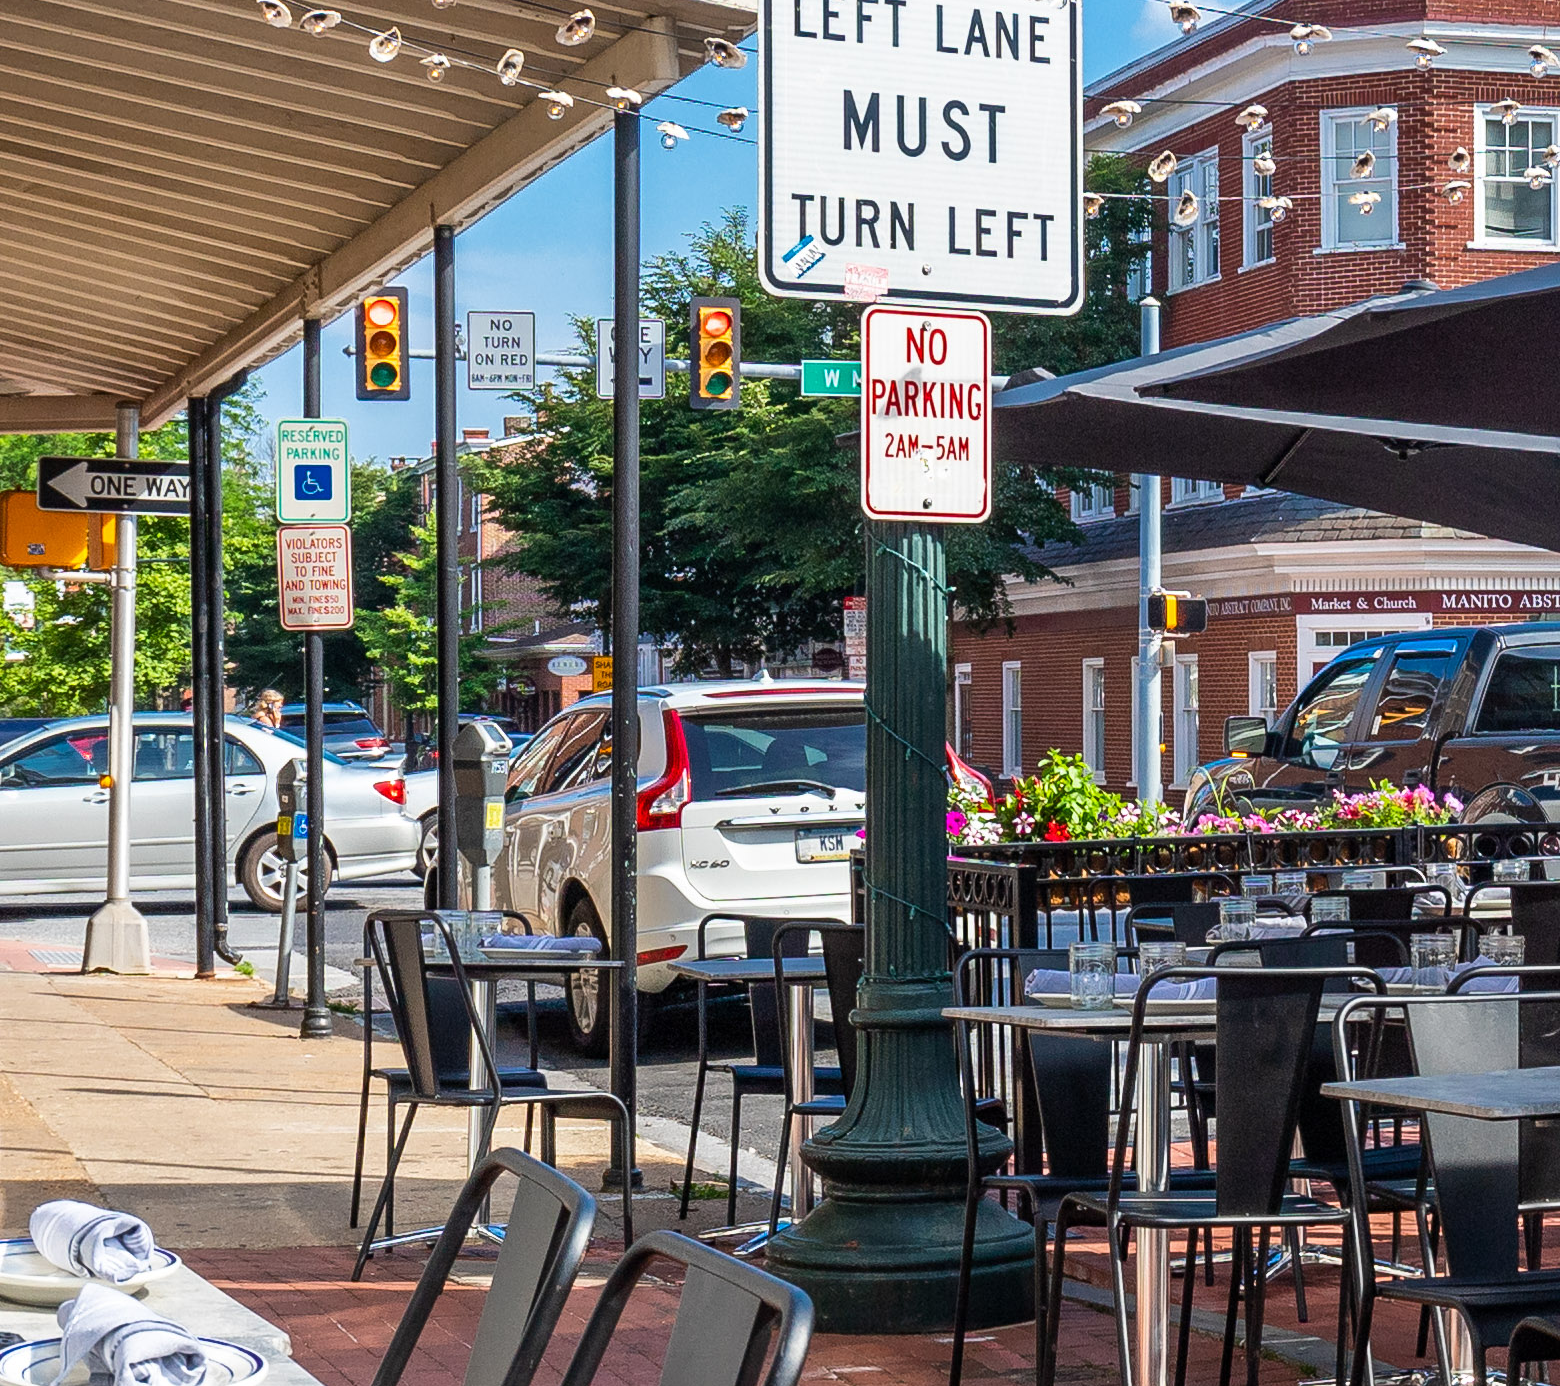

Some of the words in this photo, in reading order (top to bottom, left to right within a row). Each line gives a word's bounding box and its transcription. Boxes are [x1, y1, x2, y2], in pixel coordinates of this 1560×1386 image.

[936, 4, 1051, 65] LANE
[843, 89, 1006, 163] MUST
[791, 193, 915, 251] TURN
[948, 206, 1055, 262] LEFT
[490, 319, 513, 332] NO
[483, 336, 521, 349] TURN
[905, 326, 948, 366] NO
[475, 353, 494, 366] ON
[500, 353, 528, 366] RED
[823, 368, 840, 388] W
[871, 378, 982, 421] PARKING
[281, 429, 344, 443] RESERVED
[286, 447, 340, 461] PARKING
[884, 432, 970, 462] 2AM-5AM
[90, 475, 137, 497] ONE
[145, 477, 190, 499] WAY
[285, 537, 343, 550] VIOLATORS
[290, 551, 338, 563] SUBJECT
[294, 565, 307, 577] TO
[311, 565, 336, 577] FINE
[285, 579, 305, 591] AND
[309, 579, 347, 591] TOWING
[1310, 597, 1352, 611] Market
[1356, 597, 1368, 609] &
[1373, 596, 1417, 610] Church
[1441, 593, 1513, 610] MANITO
[769, 802, 865, 815] VOLV
